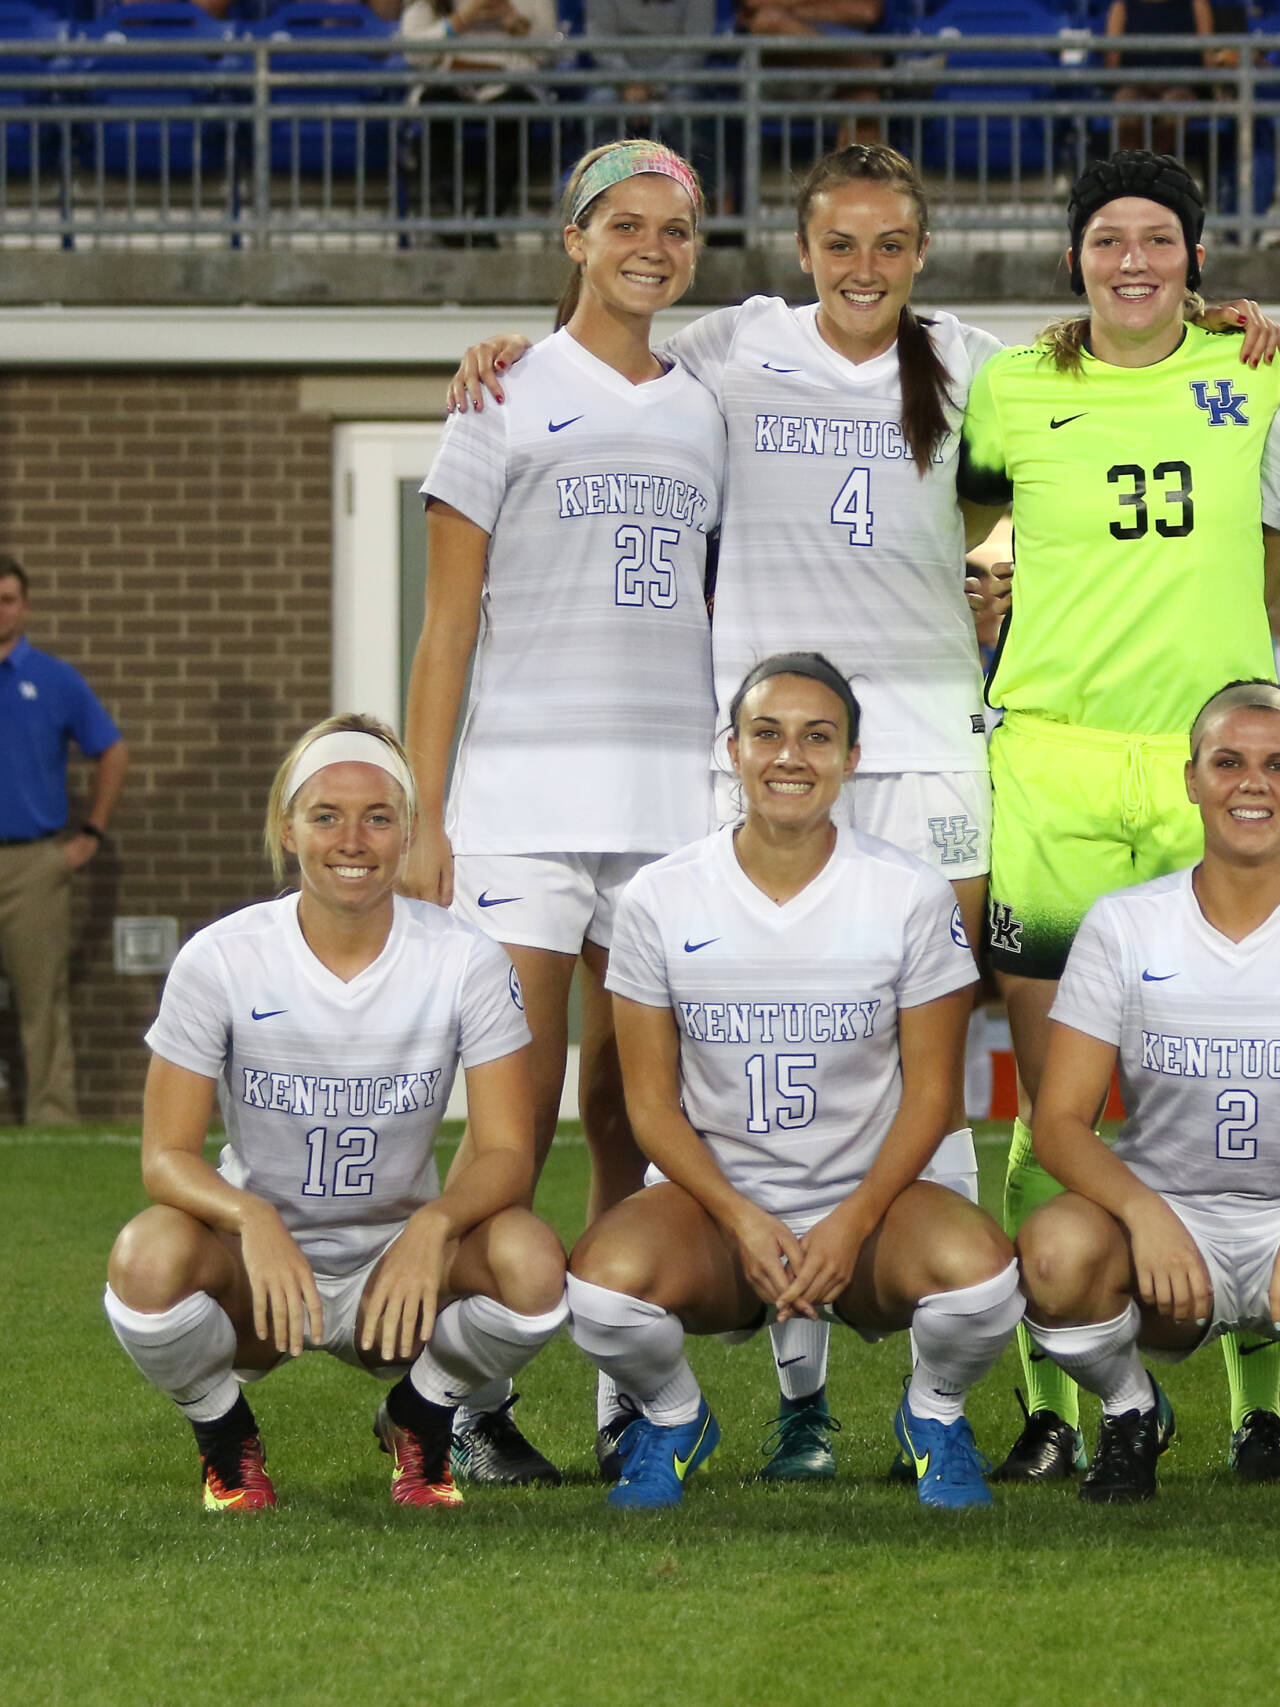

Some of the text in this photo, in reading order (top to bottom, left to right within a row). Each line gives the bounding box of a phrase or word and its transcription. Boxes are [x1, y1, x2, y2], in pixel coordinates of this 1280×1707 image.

[831, 467, 874, 546] 4
[1107, 461, 1194, 540] 33
[615, 524, 680, 609] 25
[679, 1000, 881, 1044] KENTUCKY
[242, 1067, 442, 1117] KENTUCKY
[745, 1053, 818, 1134] 15
[1215, 1088, 1259, 1160] 2
[301, 1126, 376, 1198] 12
